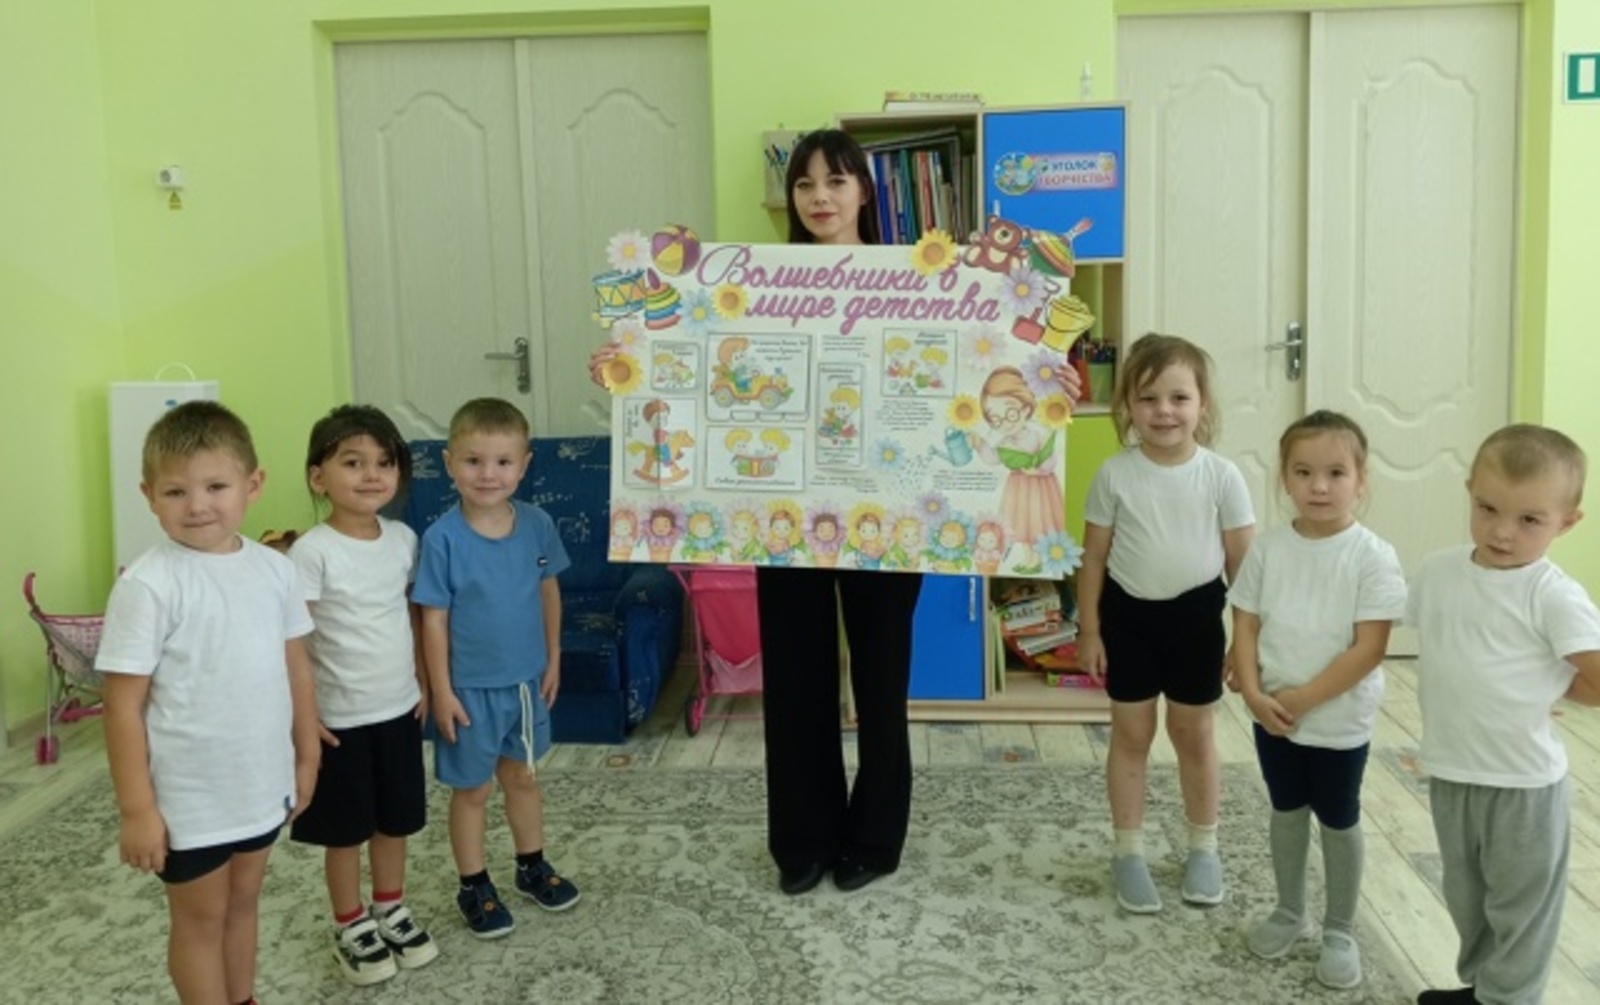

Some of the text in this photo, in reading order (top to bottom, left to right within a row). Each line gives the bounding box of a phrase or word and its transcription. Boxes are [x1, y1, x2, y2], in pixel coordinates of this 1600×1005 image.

[697, 244, 928, 292] Волшебники
[744, 280, 1001, 336] мире детства
